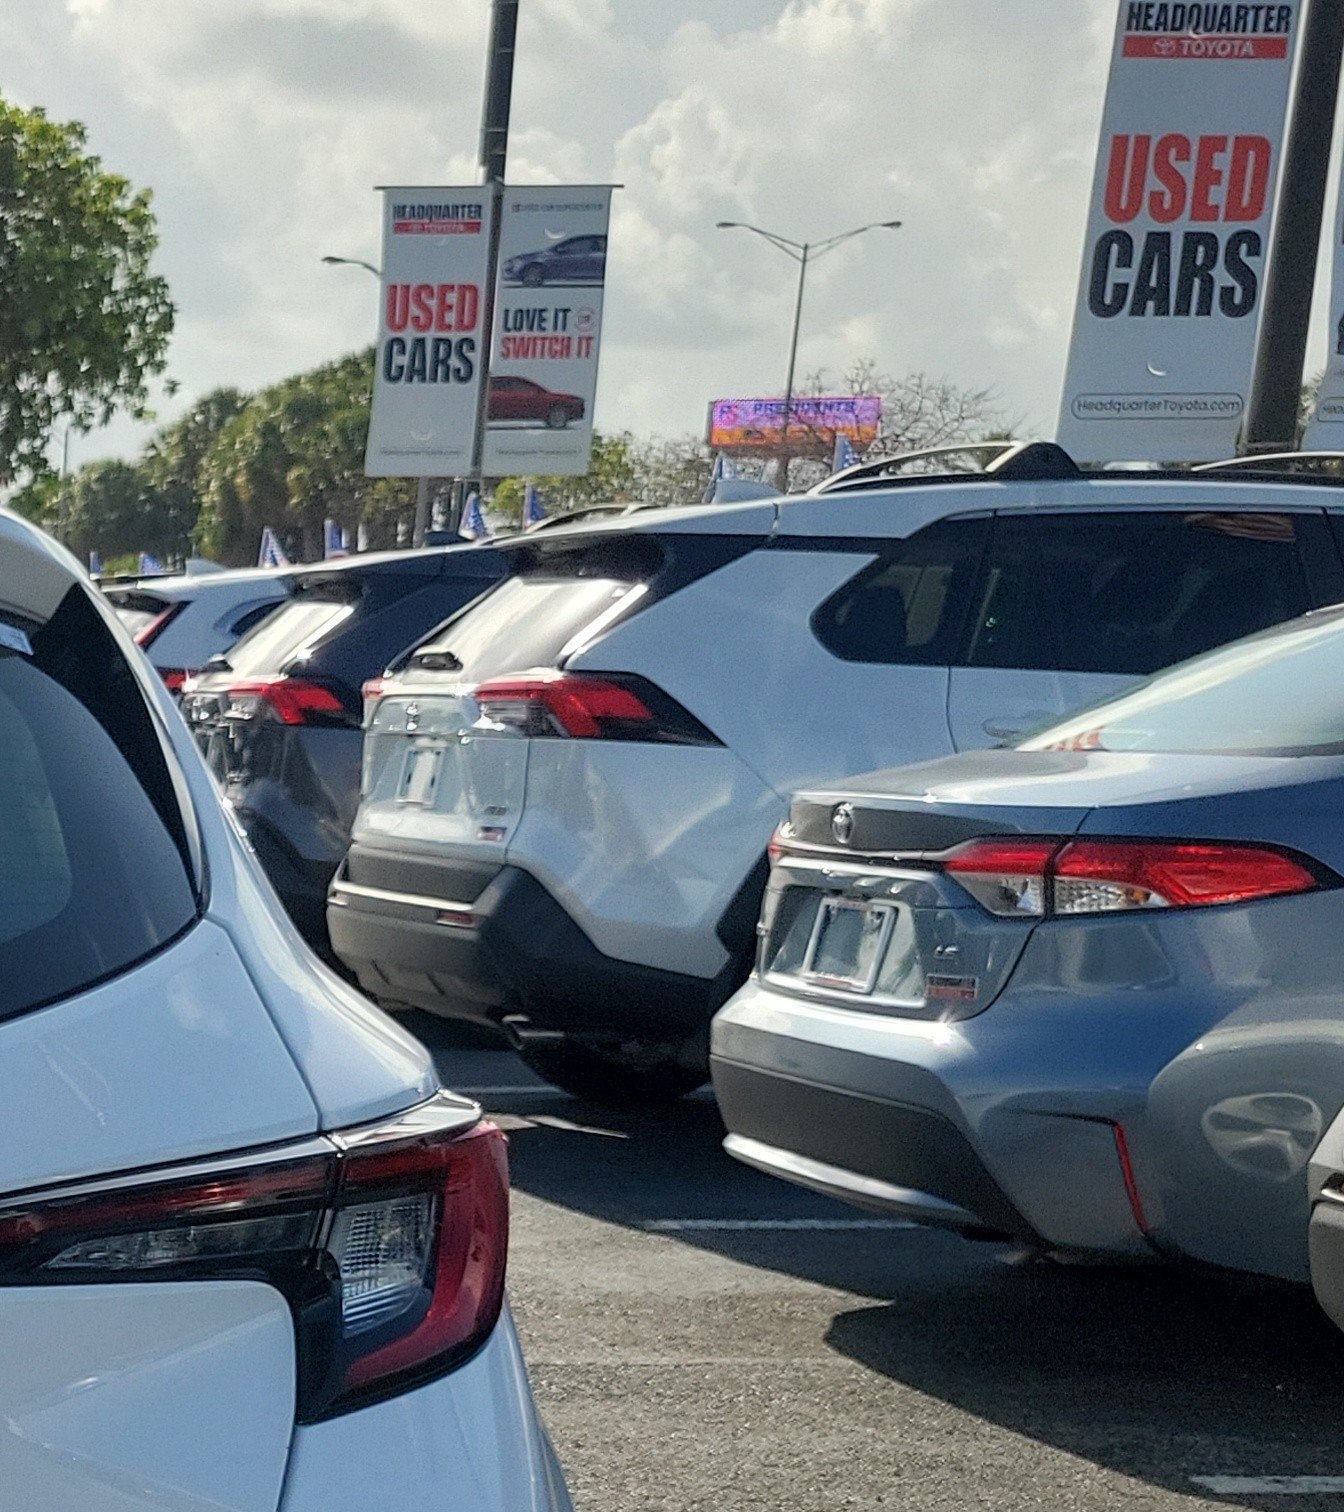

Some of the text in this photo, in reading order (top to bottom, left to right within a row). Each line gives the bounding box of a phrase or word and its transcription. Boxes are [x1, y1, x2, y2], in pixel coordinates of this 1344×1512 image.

[1125, 1, 1291, 34] HEADQUARTER
[1182, 38, 1255, 57] TOYOTA
[1103, 133, 1272, 224] USED
[1087, 229, 1262, 319] CARS
[386, 284, 479, 333] USED
[503, 307, 572, 332] LOVE IT
[383, 337, 475, 384] CARS
[501, 335, 594, 360] SWITCH IT
